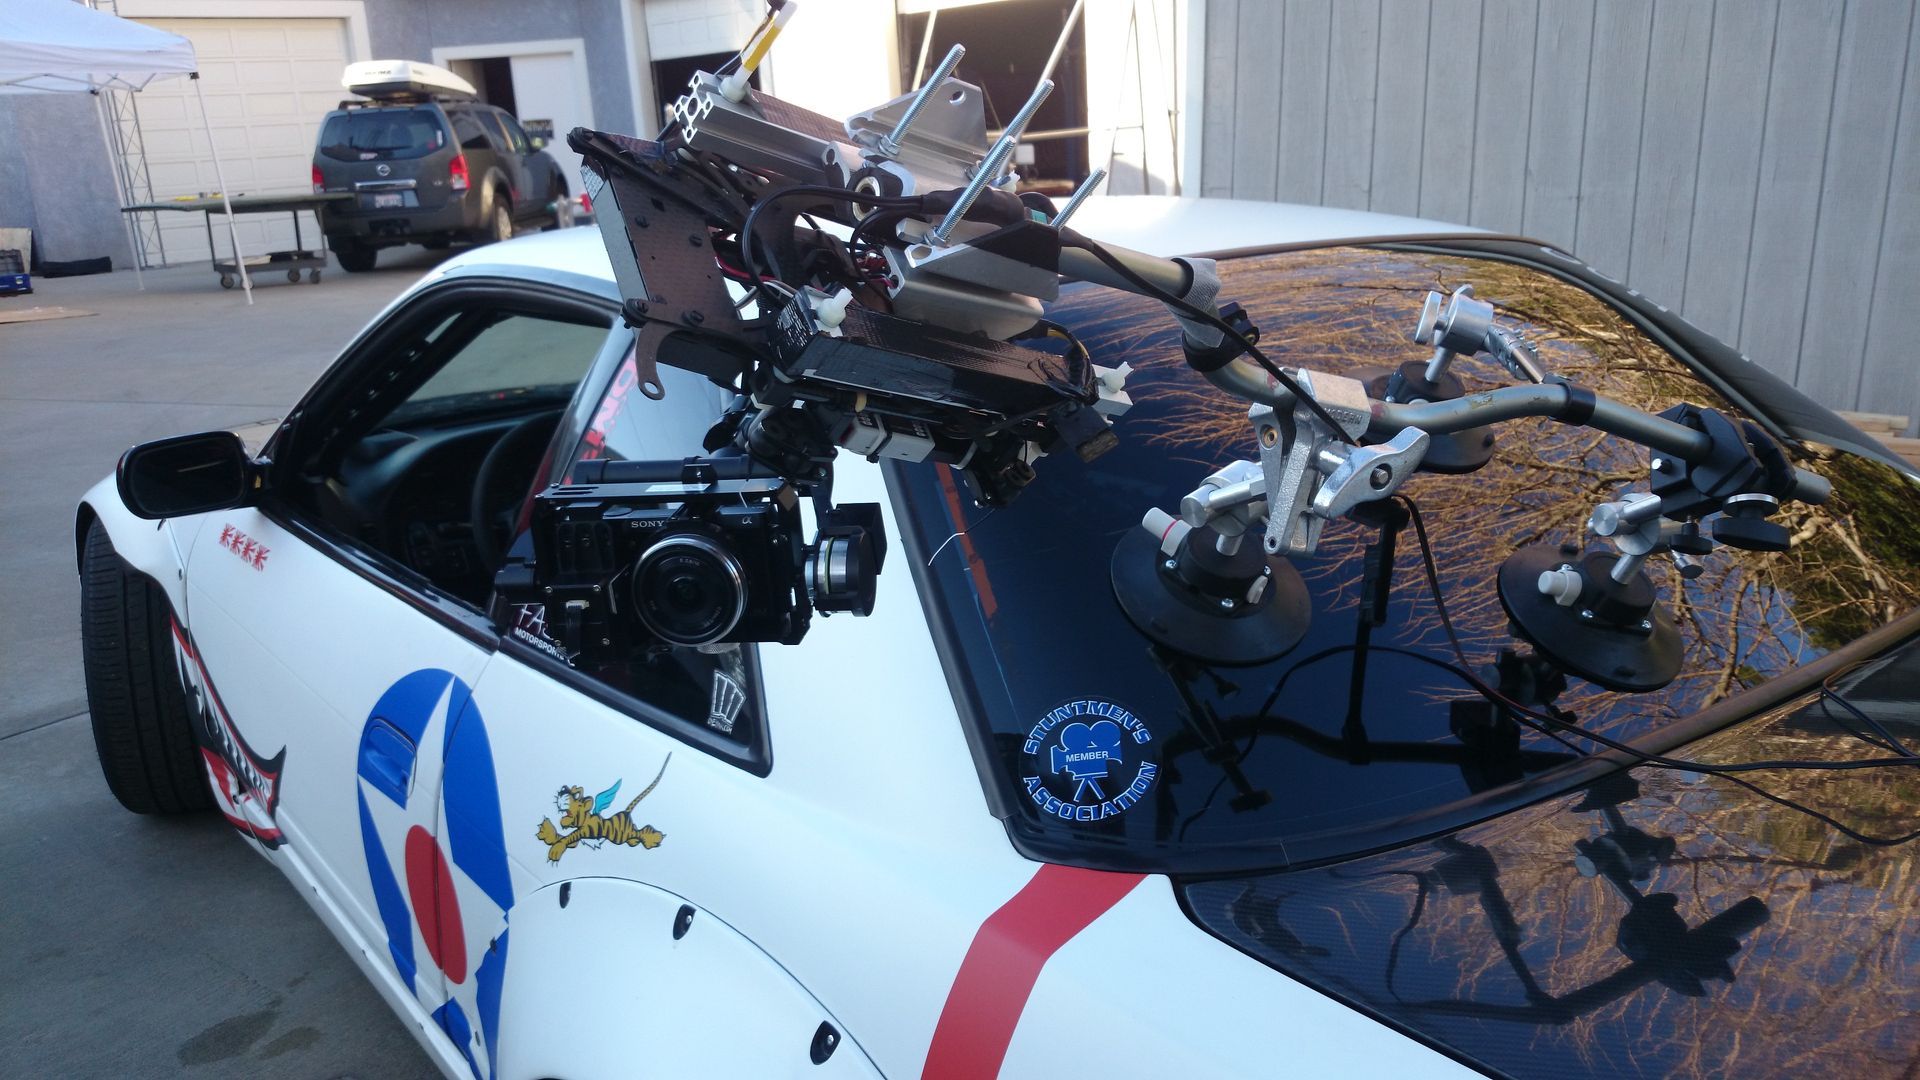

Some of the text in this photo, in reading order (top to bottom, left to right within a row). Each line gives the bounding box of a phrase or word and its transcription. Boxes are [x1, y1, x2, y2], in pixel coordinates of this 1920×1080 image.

[631, 520, 665, 528] SONY
[514, 626, 565, 661] MOTORSPOR
[1023, 700, 1153, 755] STUNTMEN'S
[1065, 750, 1109, 763] MEMBER
[1023, 760, 1158, 822] ASSOCIATION
